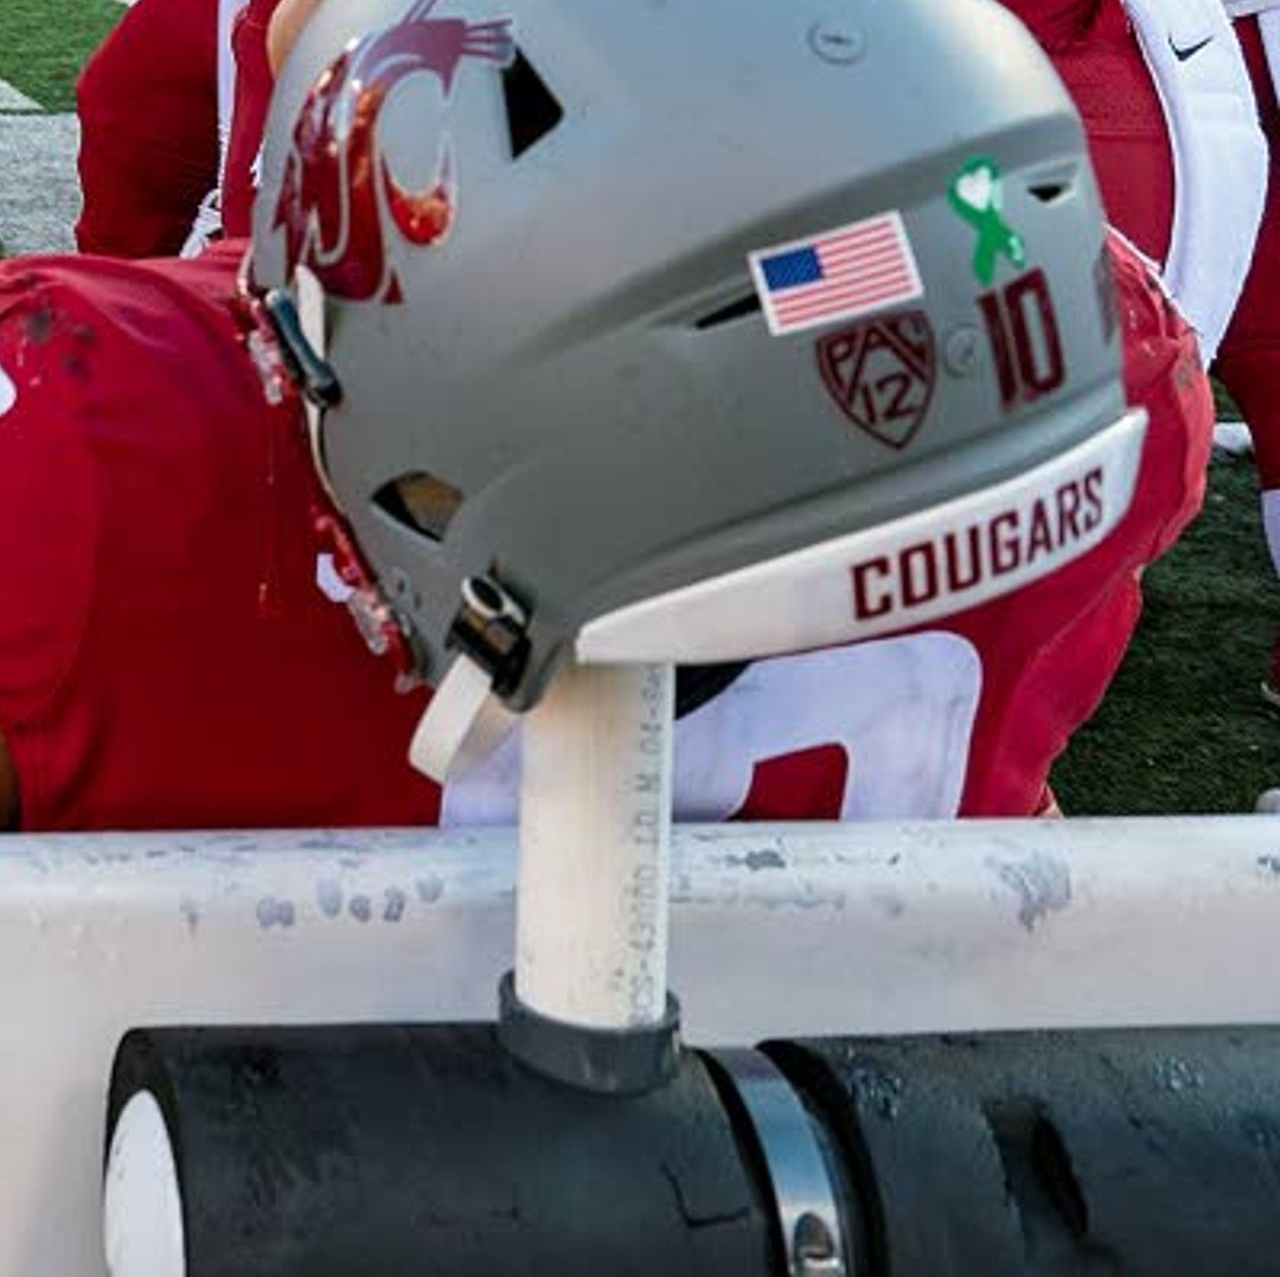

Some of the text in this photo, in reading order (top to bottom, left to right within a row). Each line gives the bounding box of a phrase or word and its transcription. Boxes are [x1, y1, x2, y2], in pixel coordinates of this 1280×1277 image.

[860, 372, 921, 425] 12
[977, 267, 1067, 415] 10
[850, 465, 1103, 621] COUGARS
